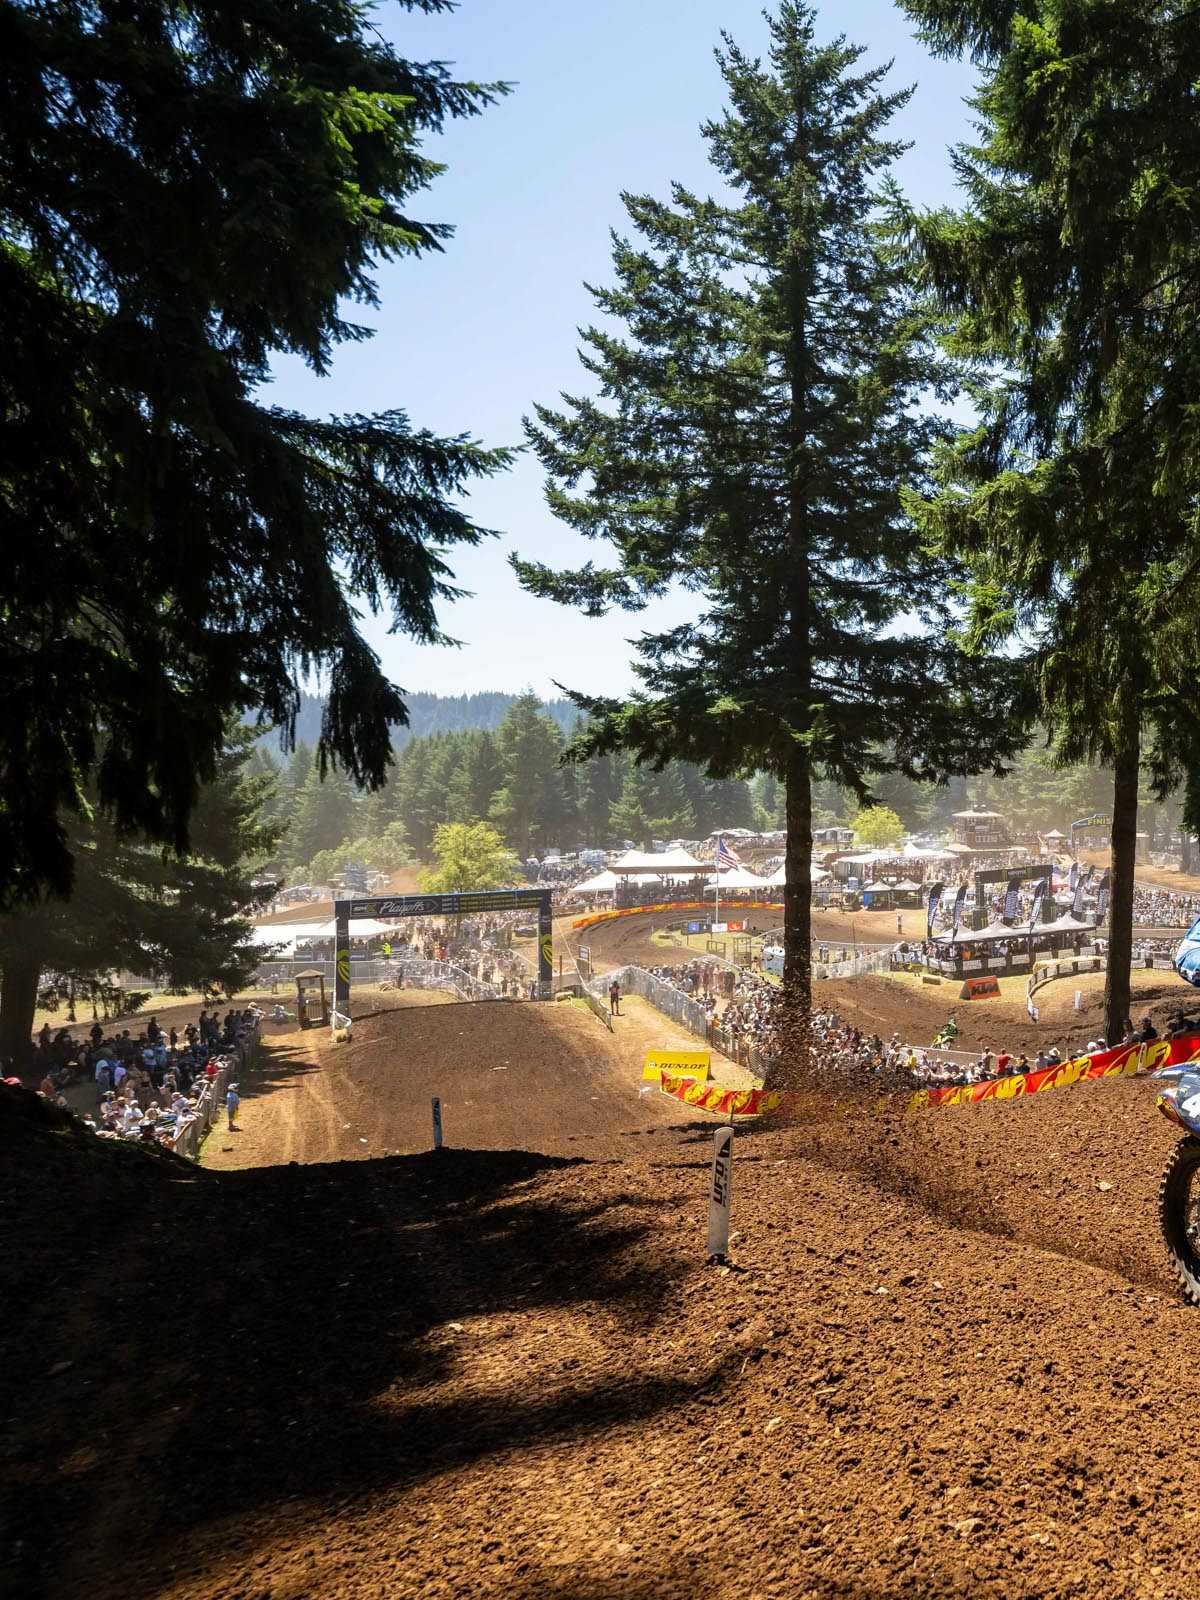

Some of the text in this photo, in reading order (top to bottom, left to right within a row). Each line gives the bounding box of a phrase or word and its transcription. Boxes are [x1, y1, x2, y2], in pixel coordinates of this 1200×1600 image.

[379, 901, 425, 915] Playoffs
[971, 982, 998, 996] KTM
[658, 1062, 706, 1070] DUNLOP
[713, 1160, 725, 1206] UFO
